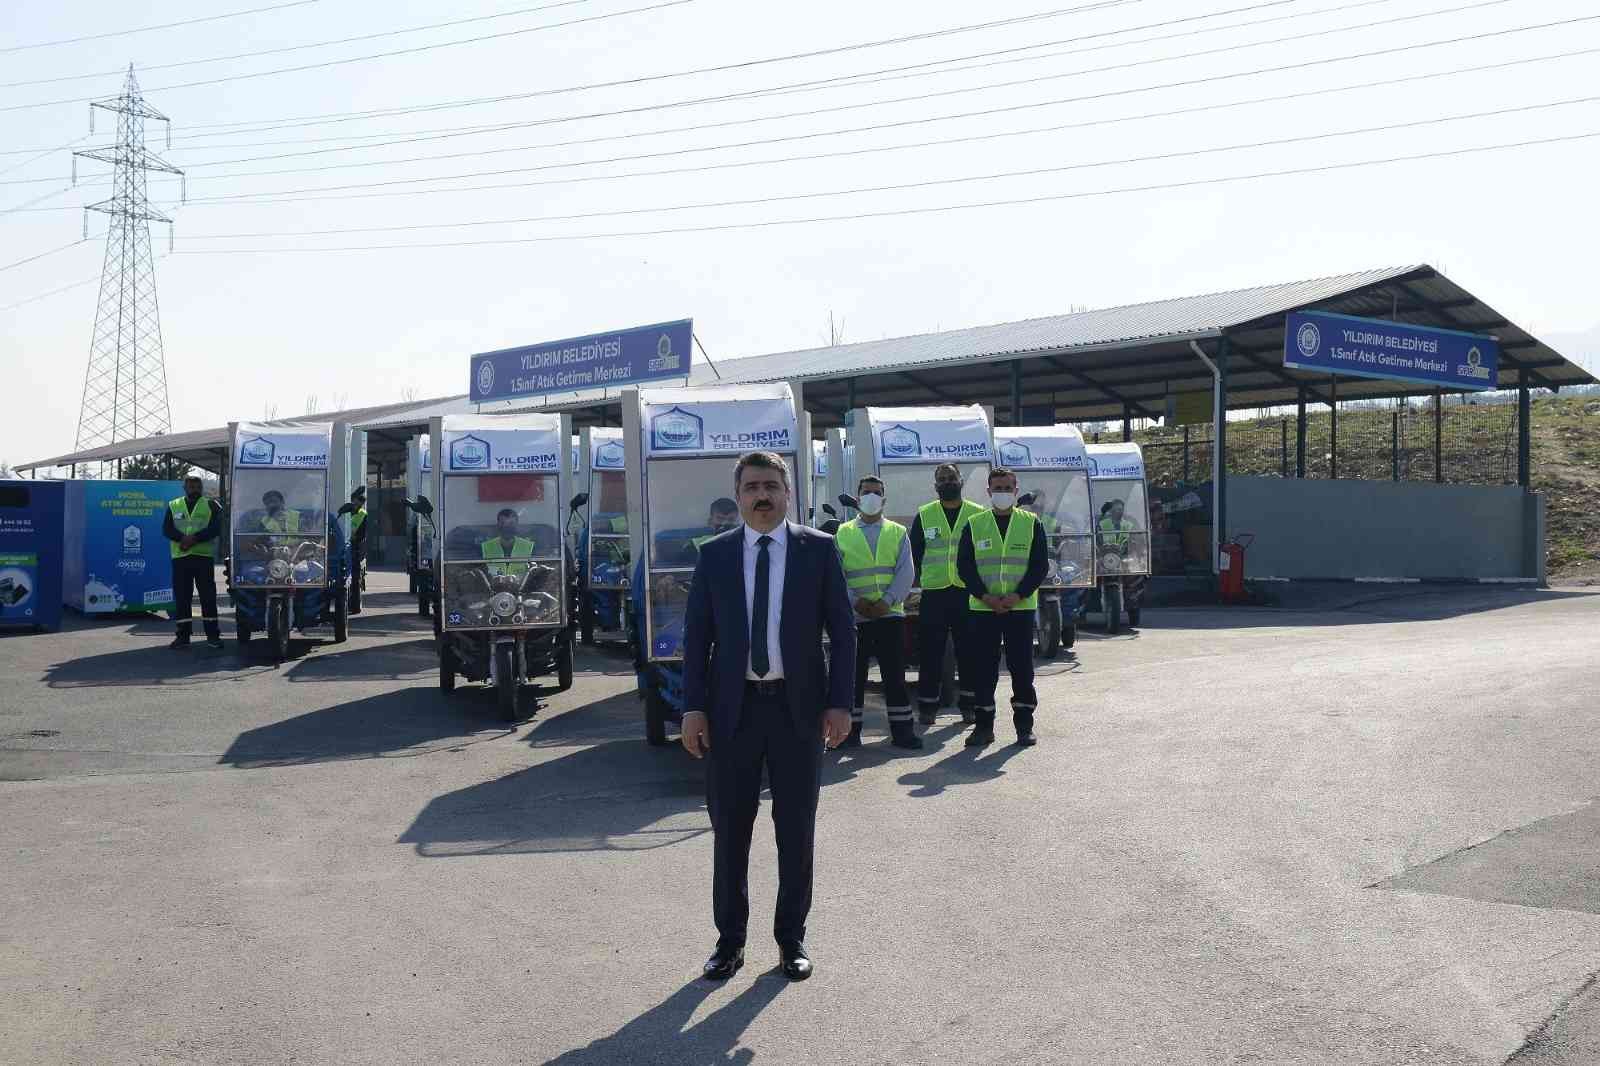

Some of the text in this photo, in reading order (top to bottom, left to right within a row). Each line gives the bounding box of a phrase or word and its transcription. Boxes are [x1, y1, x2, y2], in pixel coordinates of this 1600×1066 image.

[1343, 329, 1438, 353] YILDIRIM BELEDİYESİ
[521, 350, 561, 370] YILDIRIM
[562, 336, 621, 364] BELEDİYESİ
[1378, 353, 1413, 369] Getirme
[1414, 358, 1448, 373] Merkezi
[556, 370, 593, 387] Getirme
[593, 361, 632, 382] Merkezi
[709, 428, 789, 443] YILDIRIM
[925, 442, 986, 453] YILDIRIM
[495, 454, 556, 464] YILDIRIM
[449, 614, 460, 623] 32
